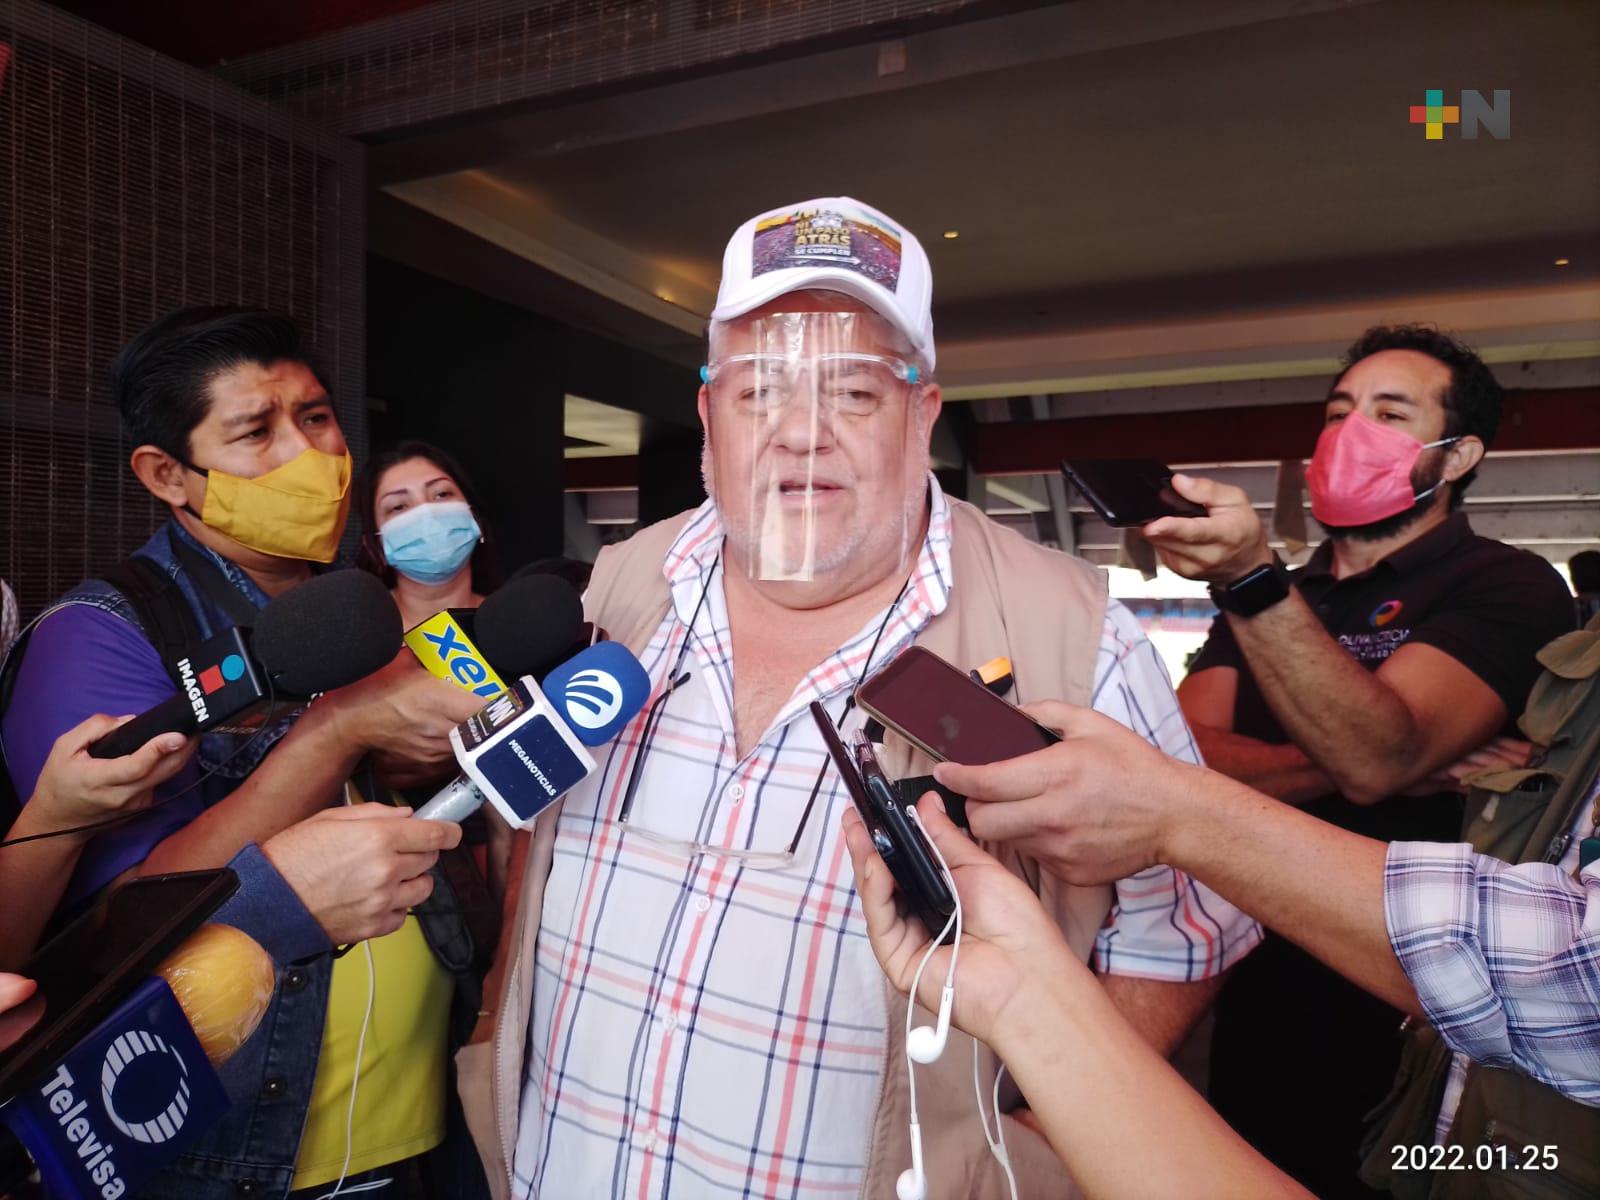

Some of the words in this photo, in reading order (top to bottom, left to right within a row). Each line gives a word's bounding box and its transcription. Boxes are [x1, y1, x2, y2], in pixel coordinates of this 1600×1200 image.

[177, 657, 210, 723] IMAGEN
[508, 739, 557, 796] MEGANOTICIAS
[40, 1063, 126, 1200] Televisa
